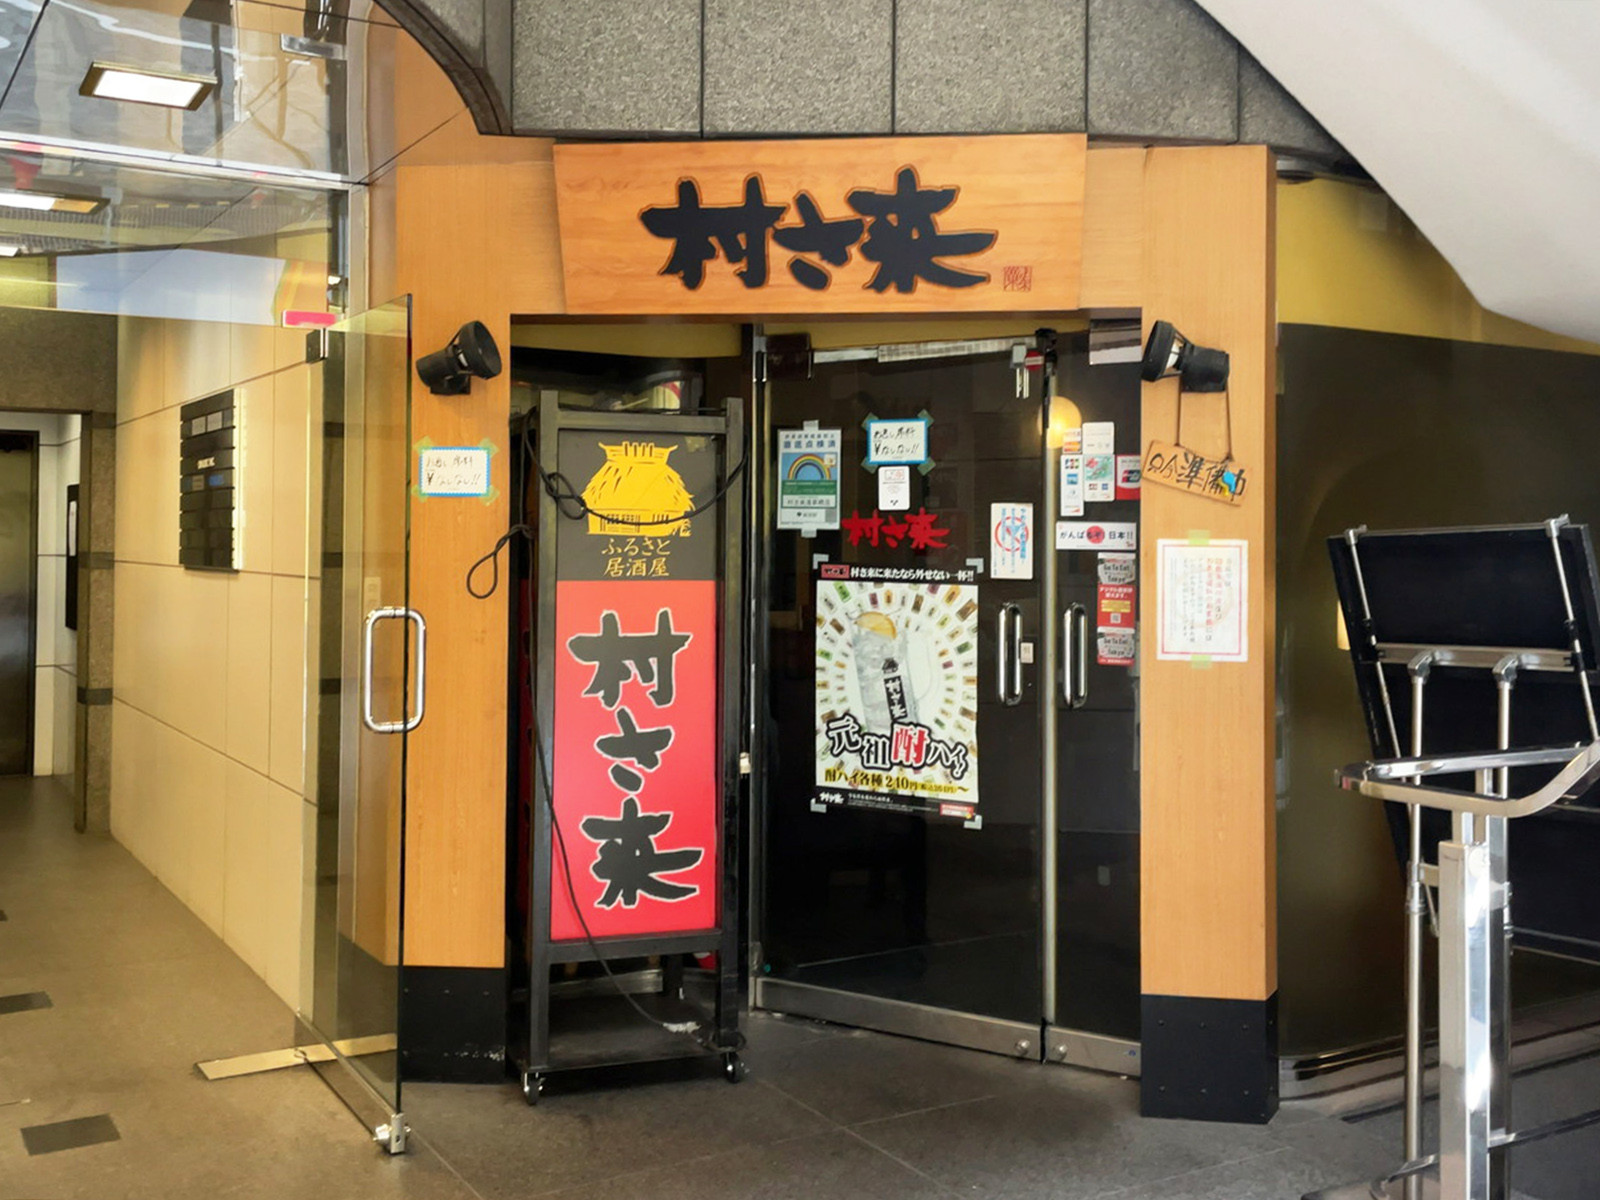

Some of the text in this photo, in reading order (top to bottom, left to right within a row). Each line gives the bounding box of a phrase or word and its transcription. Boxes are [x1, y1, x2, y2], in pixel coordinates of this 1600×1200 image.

[640, 165, 998, 293] 村さ来
[601, 537, 671, 556] ふるさと
[842, 506, 951, 549] 村さ来
[603, 557, 670, 578] 居酒屋
[565, 607, 704, 910] 村さ来
